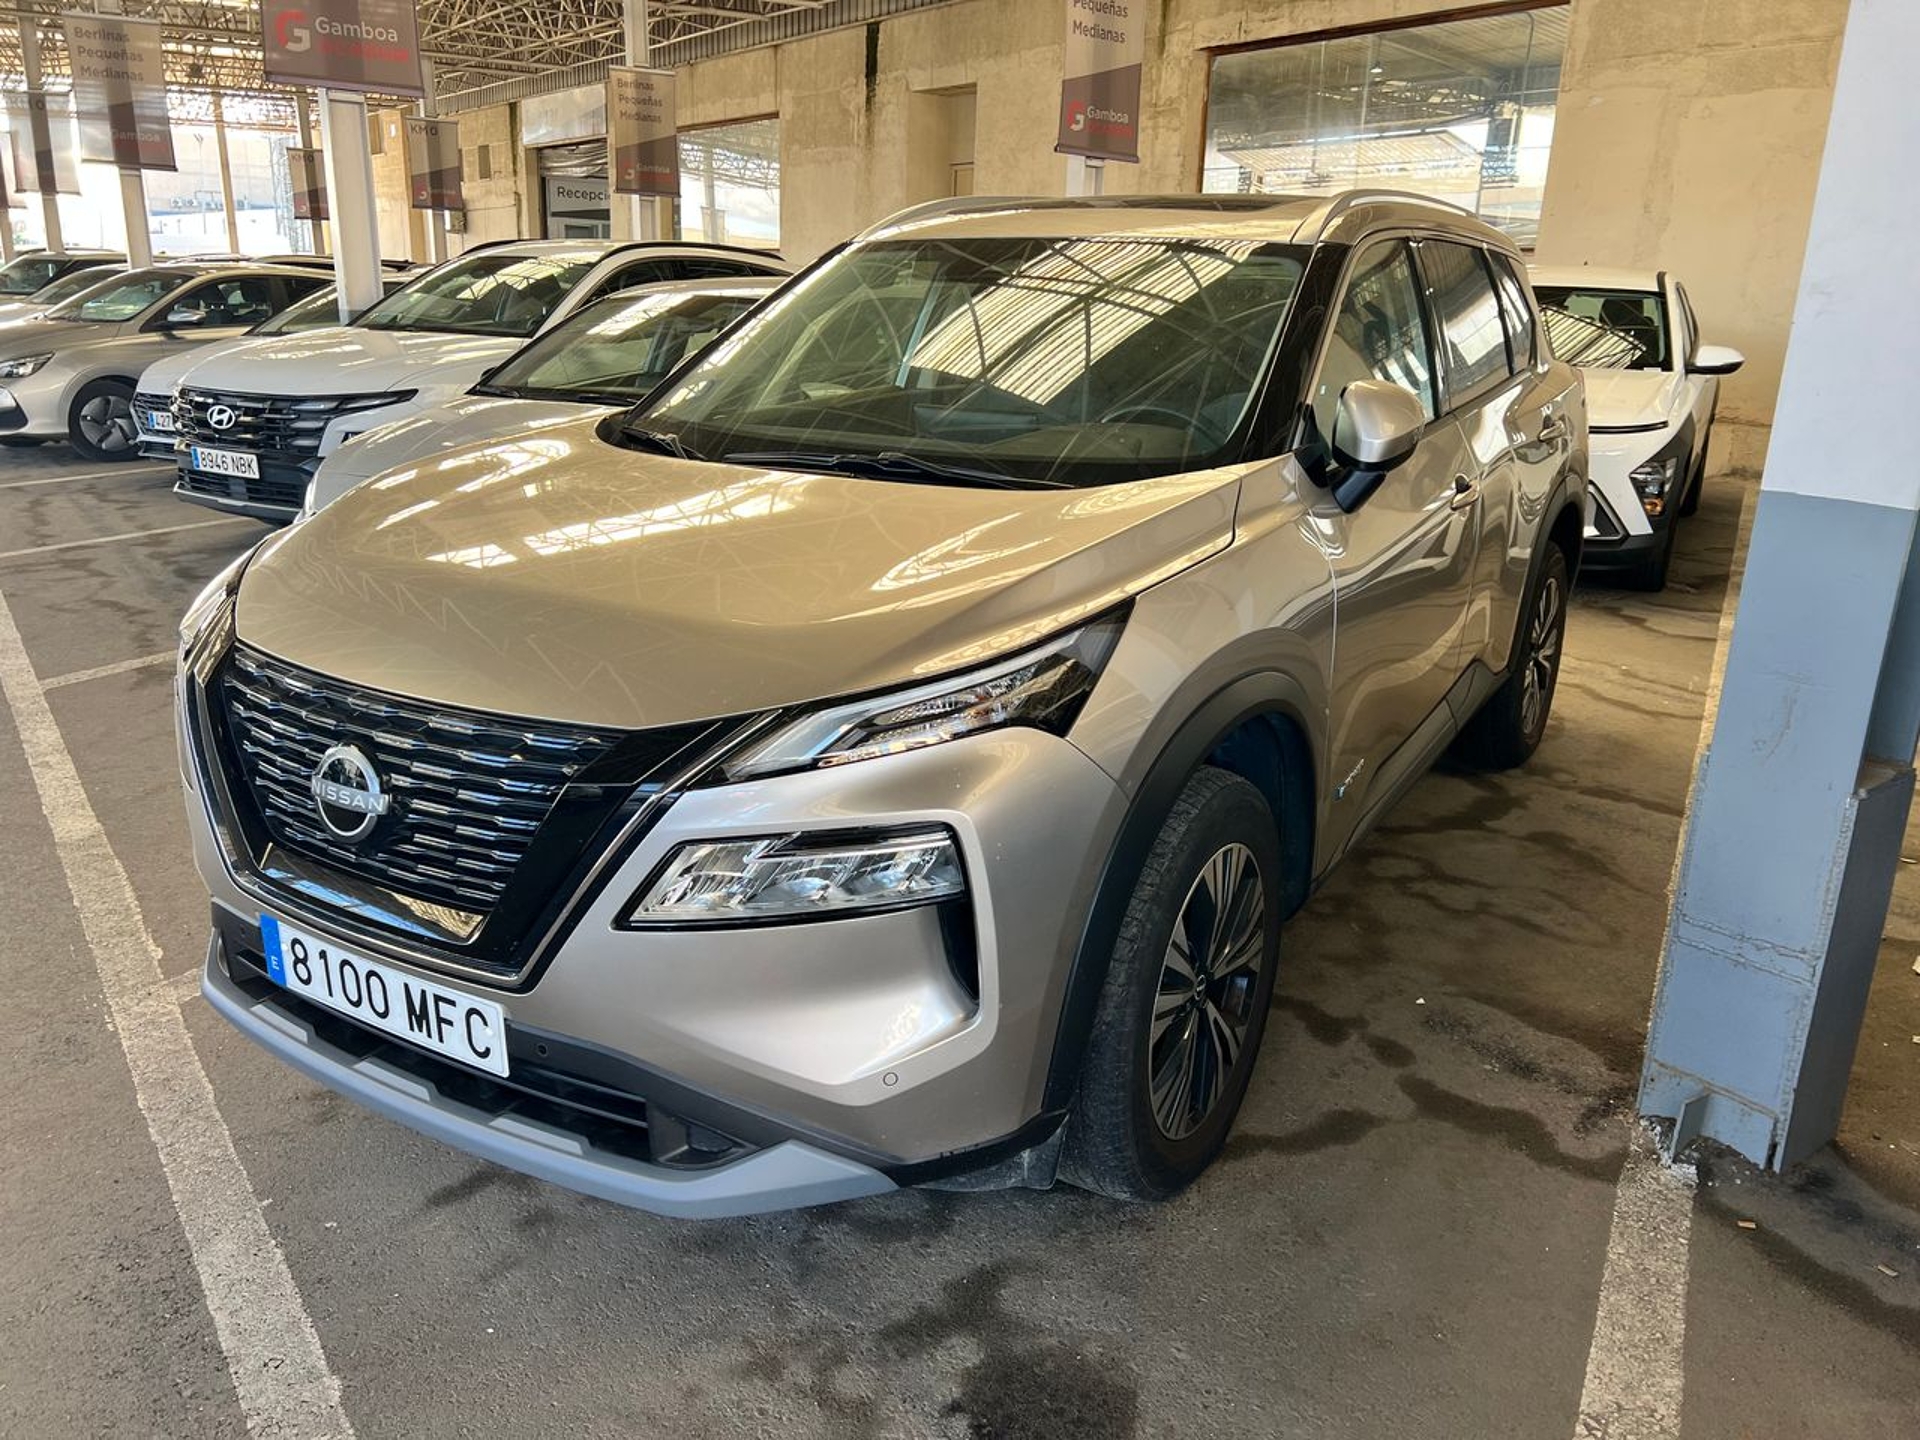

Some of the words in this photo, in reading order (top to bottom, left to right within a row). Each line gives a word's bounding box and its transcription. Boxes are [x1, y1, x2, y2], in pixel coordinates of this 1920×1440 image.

[74, 26, 130, 42] Berlinas
[315, 16, 398, 42] Gamboa
[1073, 20, 1126, 43] Medianas
[77, 45, 144, 62] Pequeñas
[80, 66, 144, 82] Medianas
[1087, 106, 1128, 124] Gamboa
[557, 186, 609, 201] Recepci
[200, 451, 229, 471] 8946
[231, 455, 256, 475] NBK
[312, 779, 384, 812] NISSAN
[290, 937, 390, 1020] 8100
[404, 982, 490, 1059] MFC
